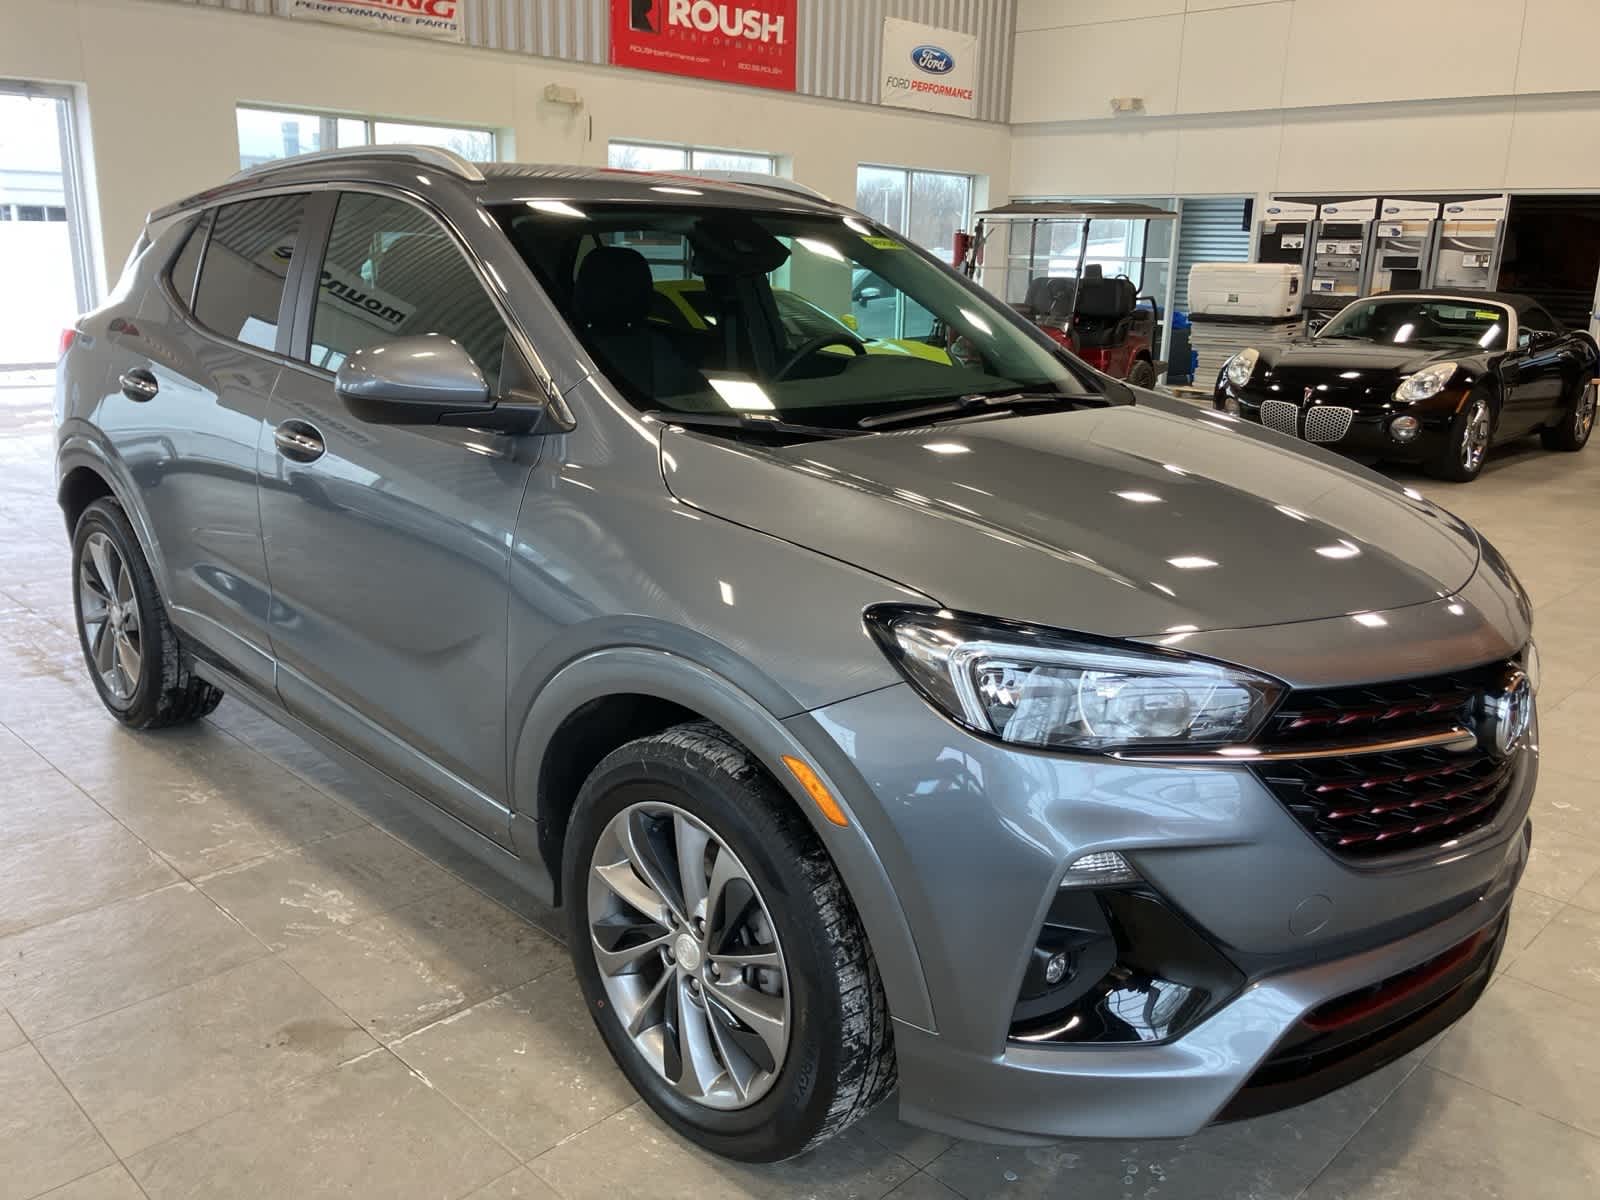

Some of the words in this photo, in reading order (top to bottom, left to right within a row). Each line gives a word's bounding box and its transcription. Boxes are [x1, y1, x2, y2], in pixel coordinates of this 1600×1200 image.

[295, 1, 411, 24] PERFORMANCE
[415, 17, 458, 31] PARTS
[668, 0, 785, 44] ROUSH
[886, 76, 910, 90] FORD
[911, 80, 973, 101] PERFORMANCE
